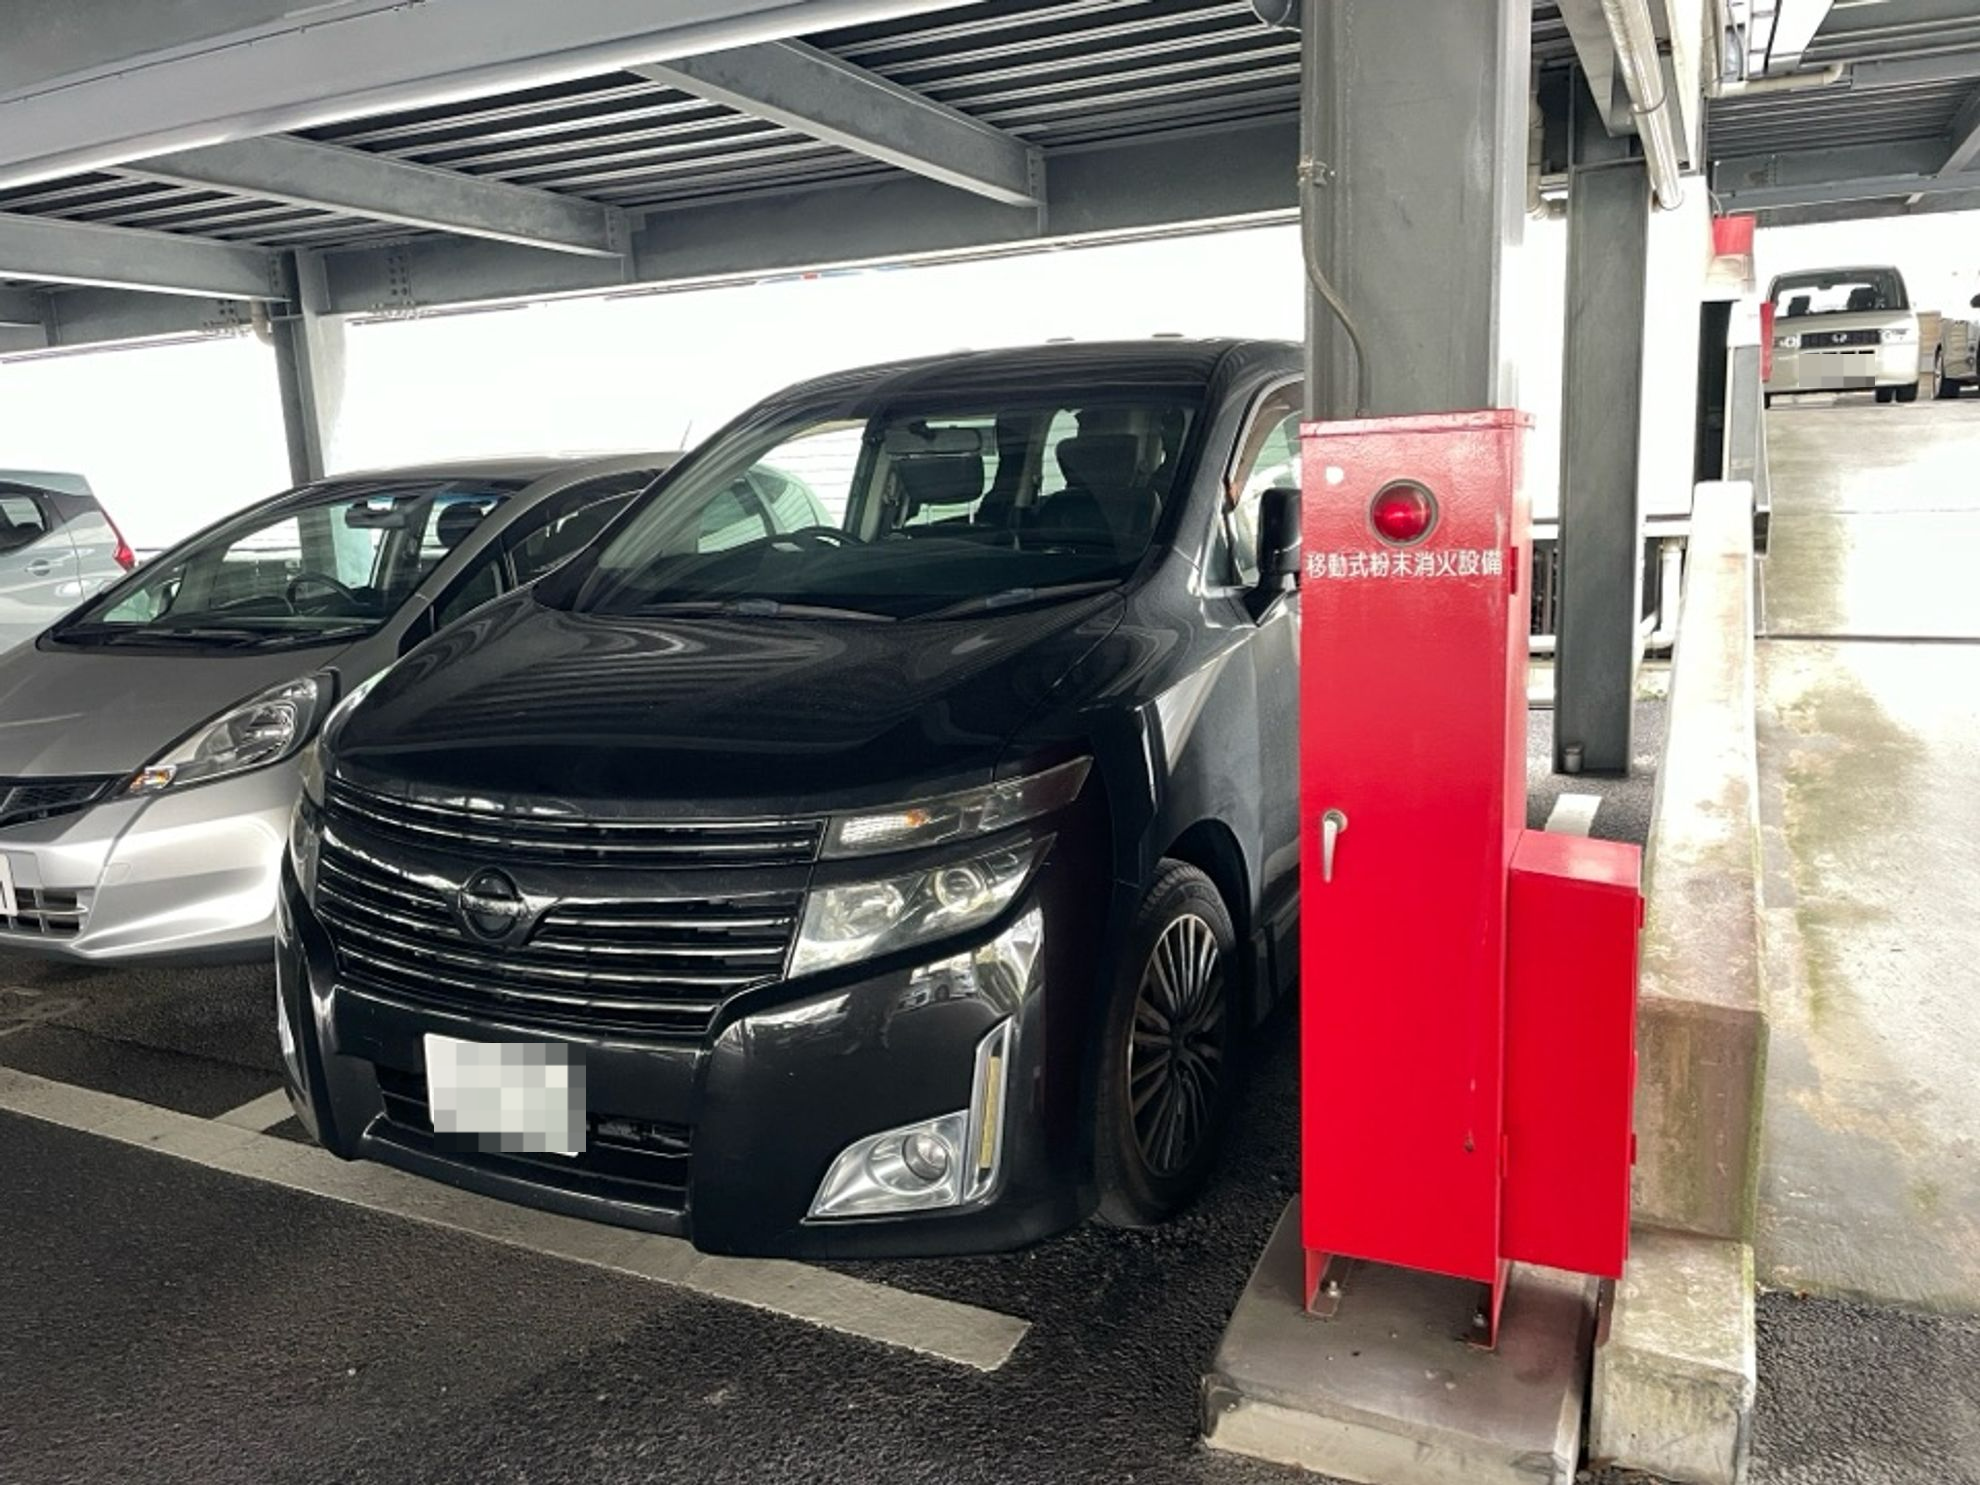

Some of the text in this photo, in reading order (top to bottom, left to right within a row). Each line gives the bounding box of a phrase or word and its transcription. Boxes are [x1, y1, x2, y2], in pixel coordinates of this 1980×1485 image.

[1306, 550, 1502, 577] 移動式粉末消火設備
